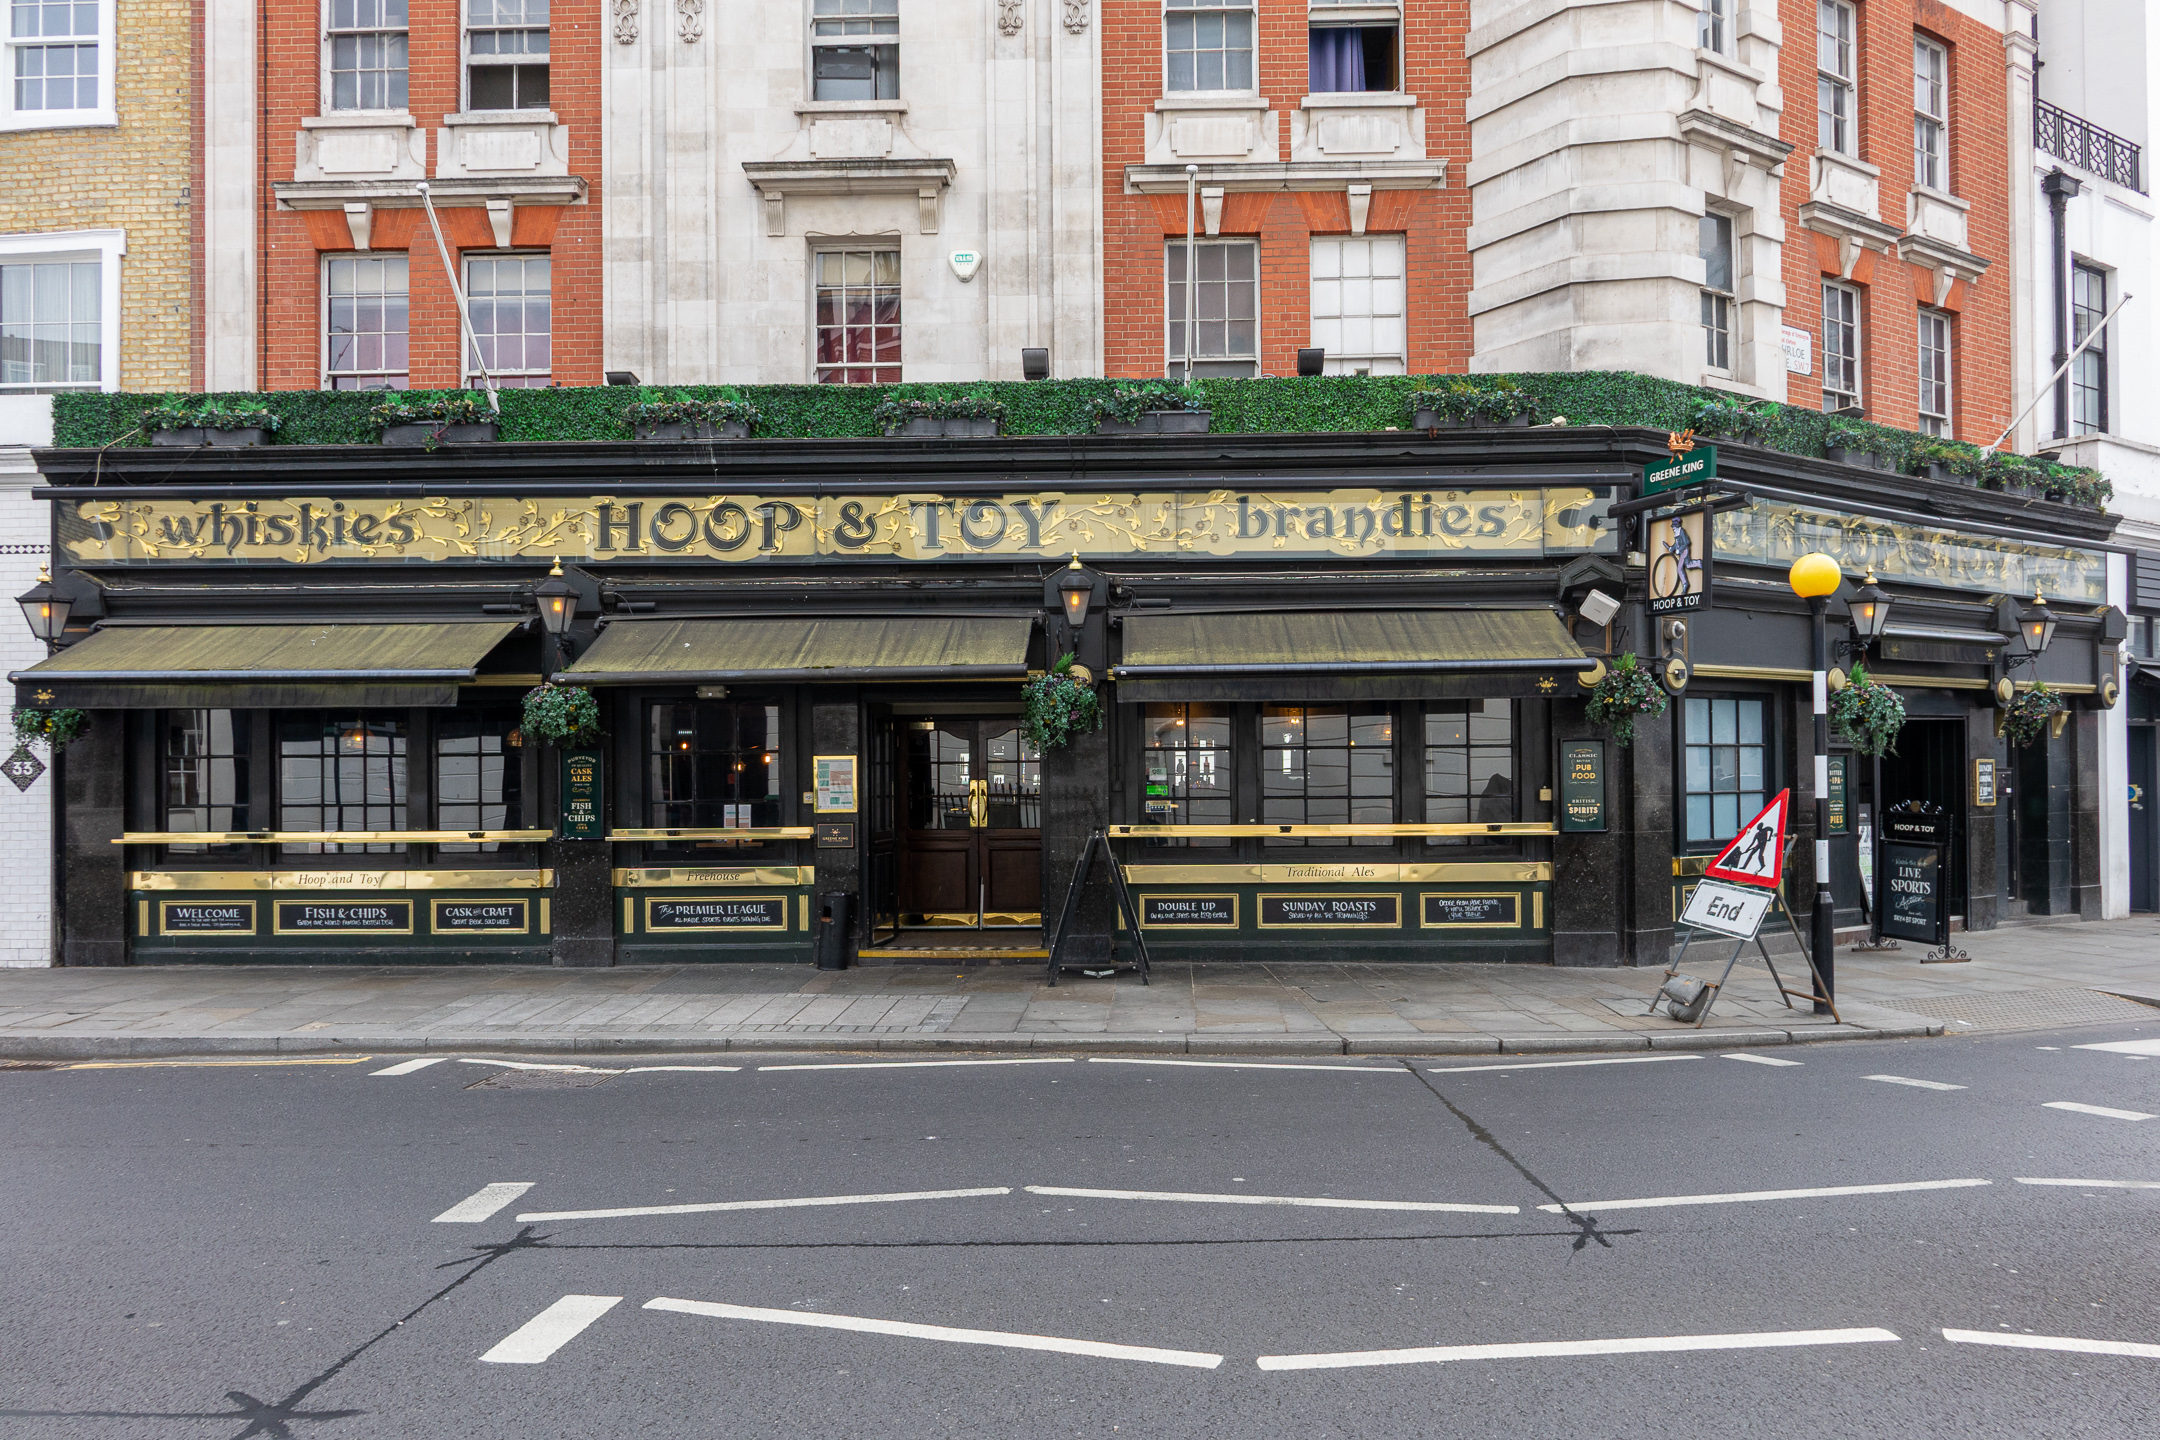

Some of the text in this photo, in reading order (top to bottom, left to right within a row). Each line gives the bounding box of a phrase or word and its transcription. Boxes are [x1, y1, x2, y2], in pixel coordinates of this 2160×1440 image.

[1650, 460, 1704, 482] GREENE KING
[594, 499, 1061, 552] HOOP & TOY
[1236, 494, 1506, 548] brandies
[158, 501, 418, 555] whiskies
[1654, 595, 1700, 610] HOOP & TOY
[12, 762, 33, 775] 33
[1830, 816, 1843, 824] PIES
[1894, 824, 1914, 832] HOOP
[686, 871, 740, 881] Freehouse
[1286, 866, 1375, 877] Traditional Ales
[1899, 867, 1922, 878] LIVE
[298, 874, 380, 886] Hoop and Toy
[1891, 879, 1931, 894] SPORTS
[1158, 902, 1216, 911] DOUBLE UP
[1282, 901, 1376, 911] SUNDAY ROASTS
[1895, 895, 1924, 910] Action
[177, 908, 240, 918] WELCOME
[305, 907, 387, 918] FISH & CHIPS
[446, 908, 473, 916] CASK
[482, 907, 514, 916] CRAFT
[676, 905, 724, 915] PREMIER
[728, 904, 766, 914] LEAGUE
[1706, 896, 1745, 921] End
[1912, 917, 1927, 925] SPORT
